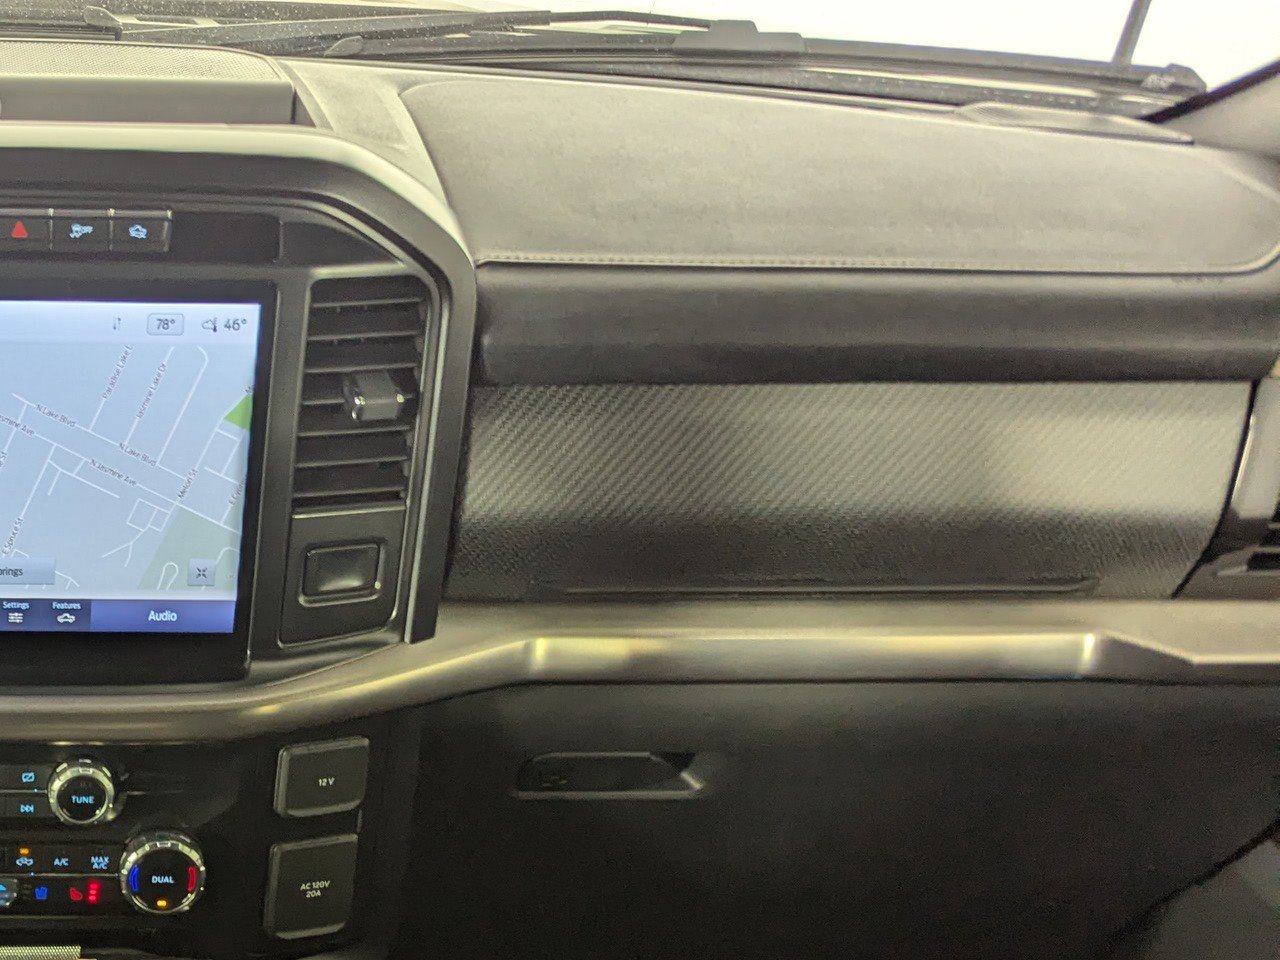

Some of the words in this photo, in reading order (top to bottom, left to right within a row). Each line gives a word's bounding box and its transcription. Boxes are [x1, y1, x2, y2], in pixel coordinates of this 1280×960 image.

[156, 318, 175, 330] 78°
[223, 318, 247, 331] 46°
[2, 601, 30, 610] Settings
[52, 602, 81, 610] Features
[148, 610, 178, 622] Audio
[71, 796, 95, 804] TUNE
[53, 858, 69, 866] A/C
[92, 862, 108, 870] A/C
[300, 882, 311, 891] AC
[312, 880, 331, 889] 120V
[306, 890, 322, 898] 20A
